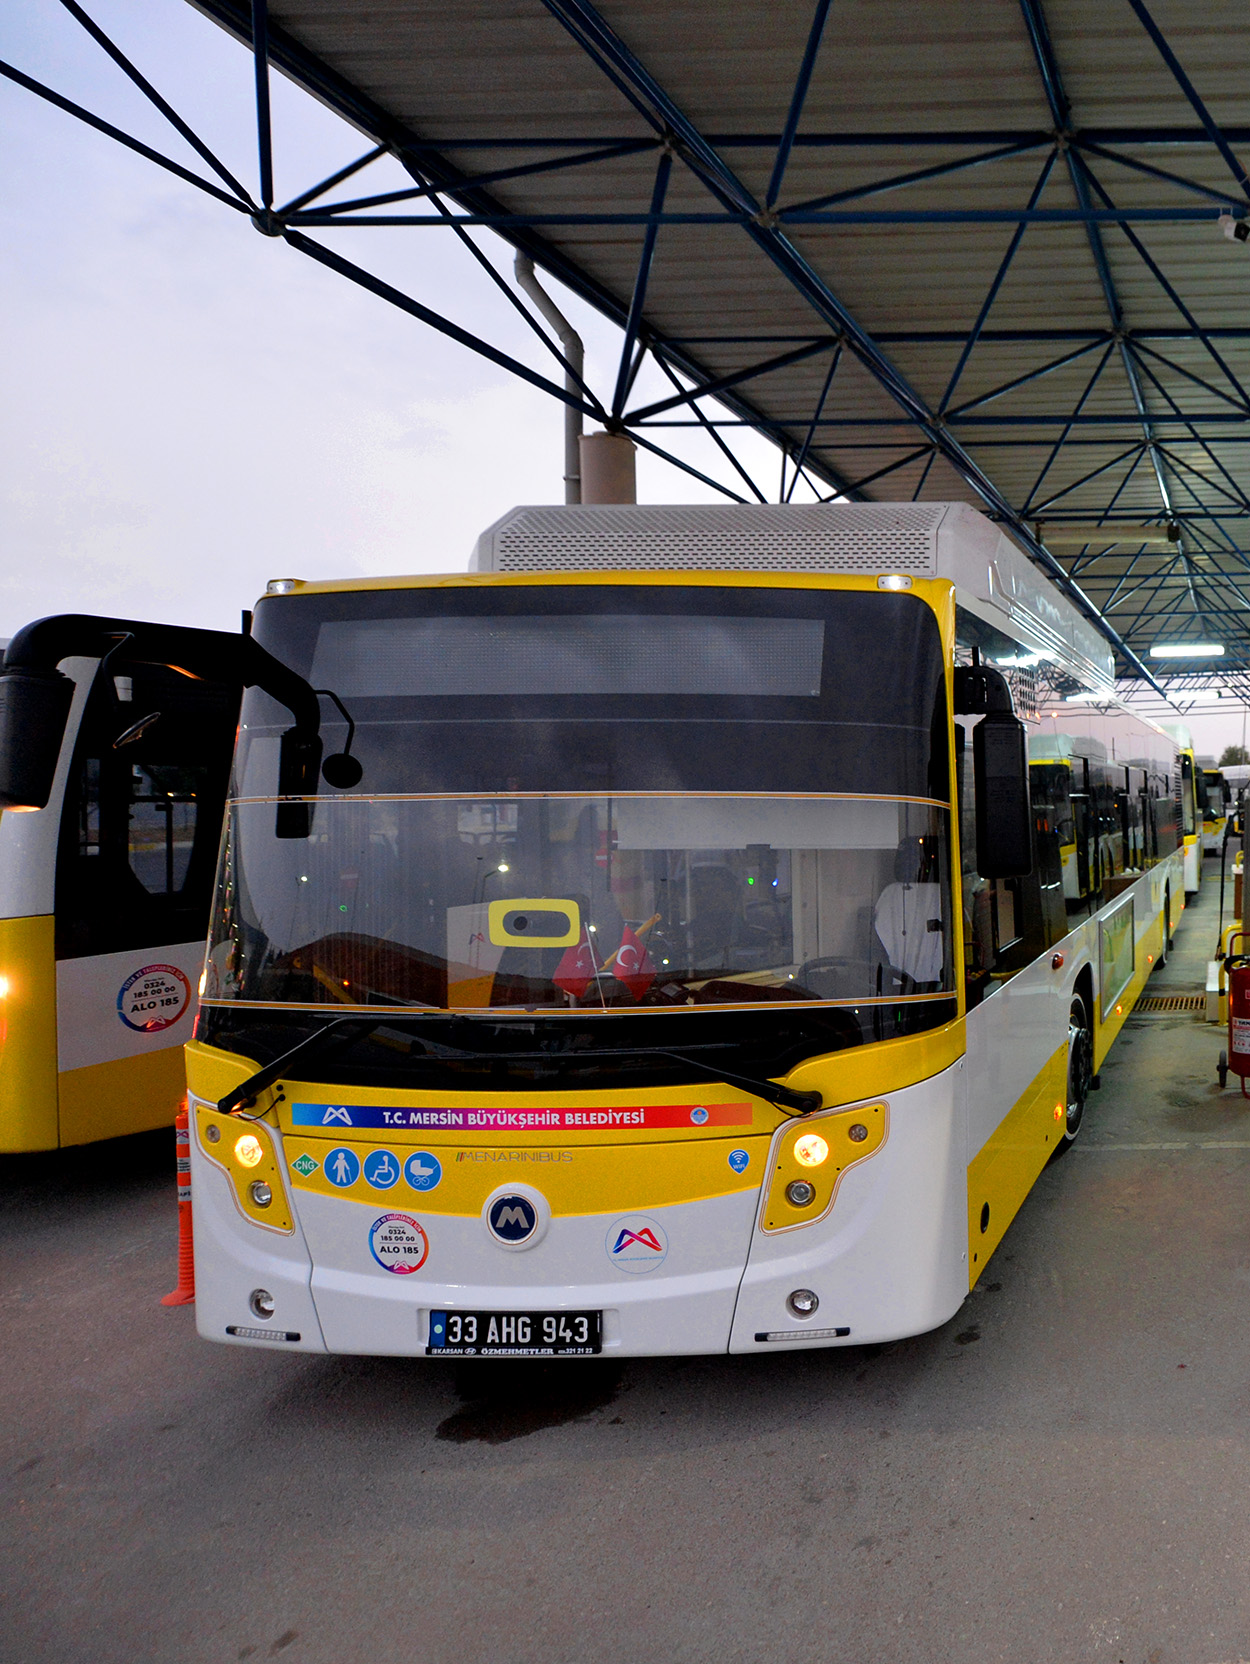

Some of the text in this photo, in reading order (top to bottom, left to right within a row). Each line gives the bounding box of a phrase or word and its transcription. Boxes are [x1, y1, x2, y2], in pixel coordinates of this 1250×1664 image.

[143, 980, 166, 989] 0324
[133, 990, 148, 998] 185
[164, 985, 176, 993] 00
[131, 996, 179, 1013] ALO 185
[383, 1108, 645, 1129] T.C. MERSİN BÜYÜKŞEHİR BELEDİYESİ
[461, 1151, 573, 1163] MENARINIBUS
[295, 1160, 315, 1170] CNG
[495, 1206, 530, 1229] M
[380, 1246, 419, 1254] ALO 185
[448, 1315, 589, 1343] 33 AHG 943
[481, 1347, 554, 1355] ÖZMEHMETLER
